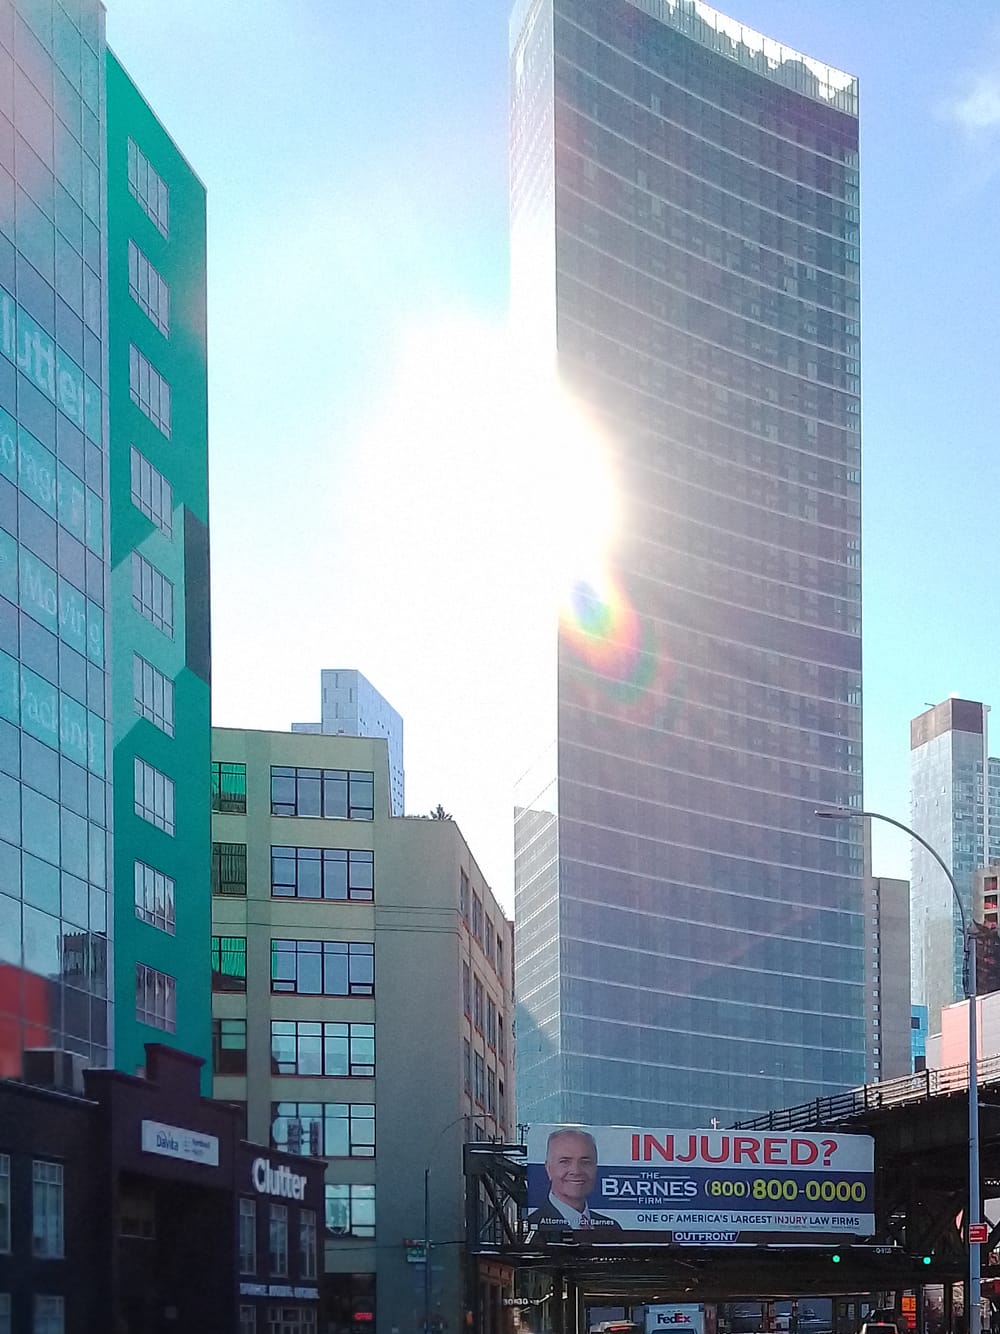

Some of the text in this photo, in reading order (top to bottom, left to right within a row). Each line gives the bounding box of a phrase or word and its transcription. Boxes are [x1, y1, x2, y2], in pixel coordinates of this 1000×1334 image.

[0, 295, 91, 426] lutter
[631, 1133, 838, 1166] INJURED?
[252, 1157, 307, 1200] Clutter
[640, 1172, 660, 1180] THE
[601, 1178, 698, 1197] BARNES
[638, 1197, 662, 1205] FIRM
[590, 1218, 614, 1226] Barnes
[637, 1214, 860, 1226] ONE OF AMERICA'S LARGEST INJURY LAW FIRMS
[674, 1232, 736, 1241] OUTFRONT
[657, 1312, 691, 1324] FedEx
